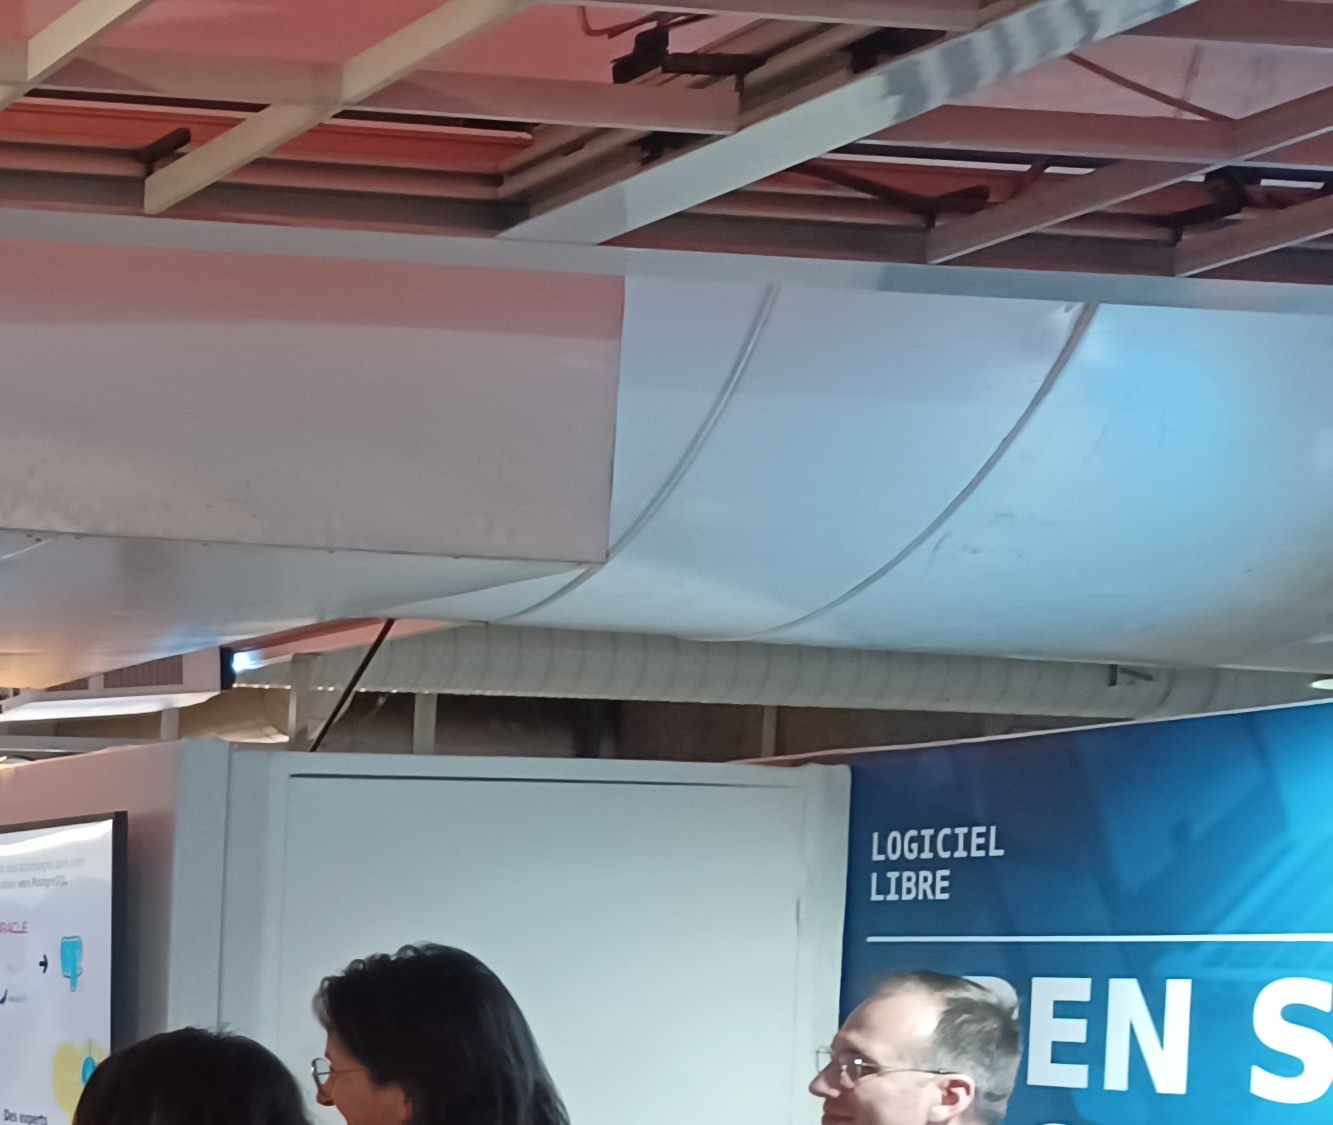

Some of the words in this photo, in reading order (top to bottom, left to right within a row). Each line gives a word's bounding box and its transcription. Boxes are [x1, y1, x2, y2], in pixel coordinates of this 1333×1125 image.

[871, 825, 1005, 861] LOGICIEL
[870, 869, 950, 901] LIBRE
[961, 975, 1192, 1095] EN
